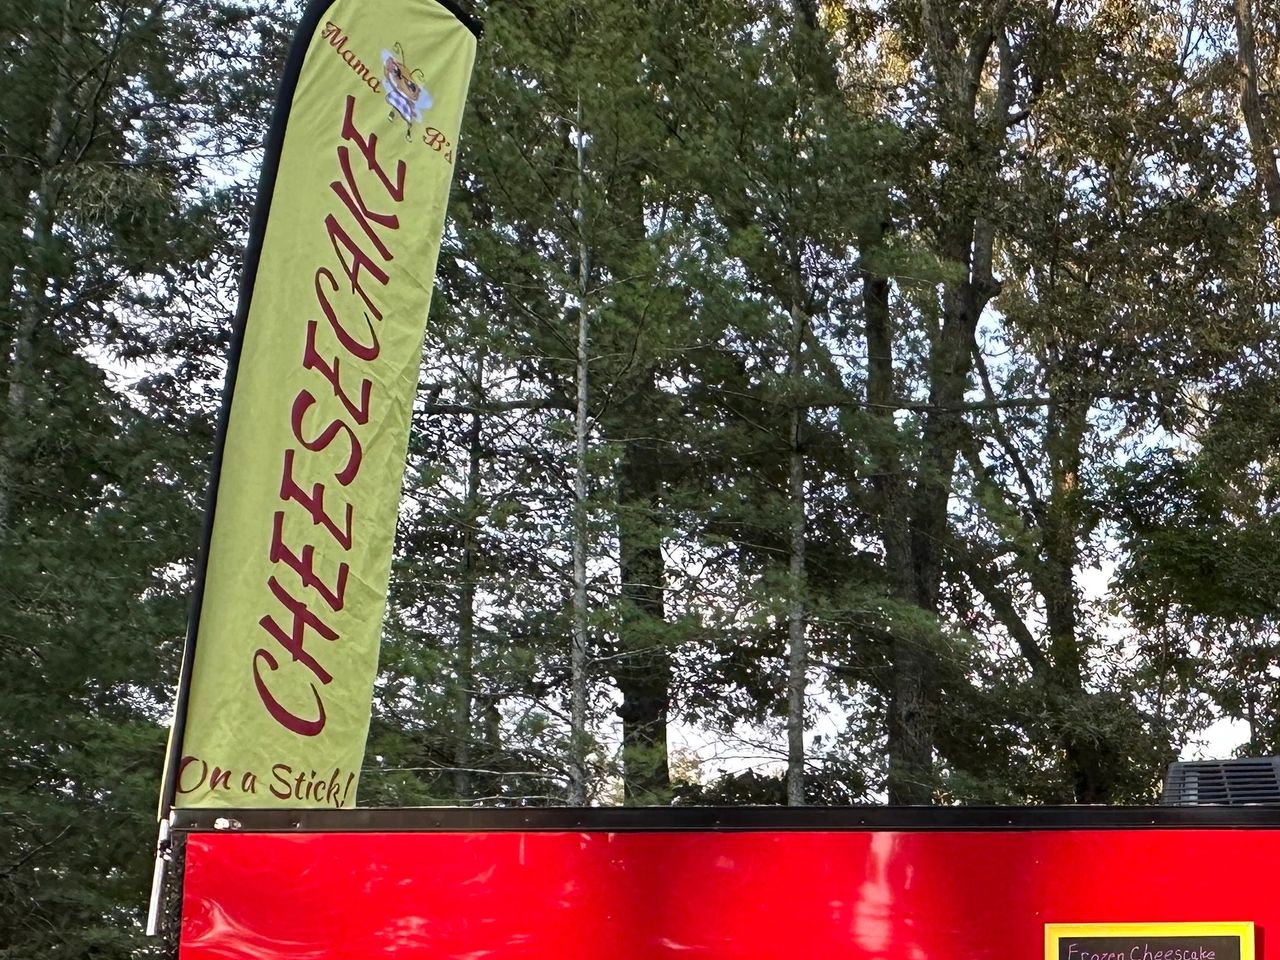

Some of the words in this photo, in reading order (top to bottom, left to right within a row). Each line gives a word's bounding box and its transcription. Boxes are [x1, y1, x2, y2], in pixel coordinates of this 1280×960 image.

[321, 20, 381, 94] Mama
[423, 126, 453, 165] B's
[252, 94, 407, 738] CHEESECAKE
[175, 755, 232, 794] On
[241, 771, 257, 794] a
[269, 763, 355, 808] Stick!
